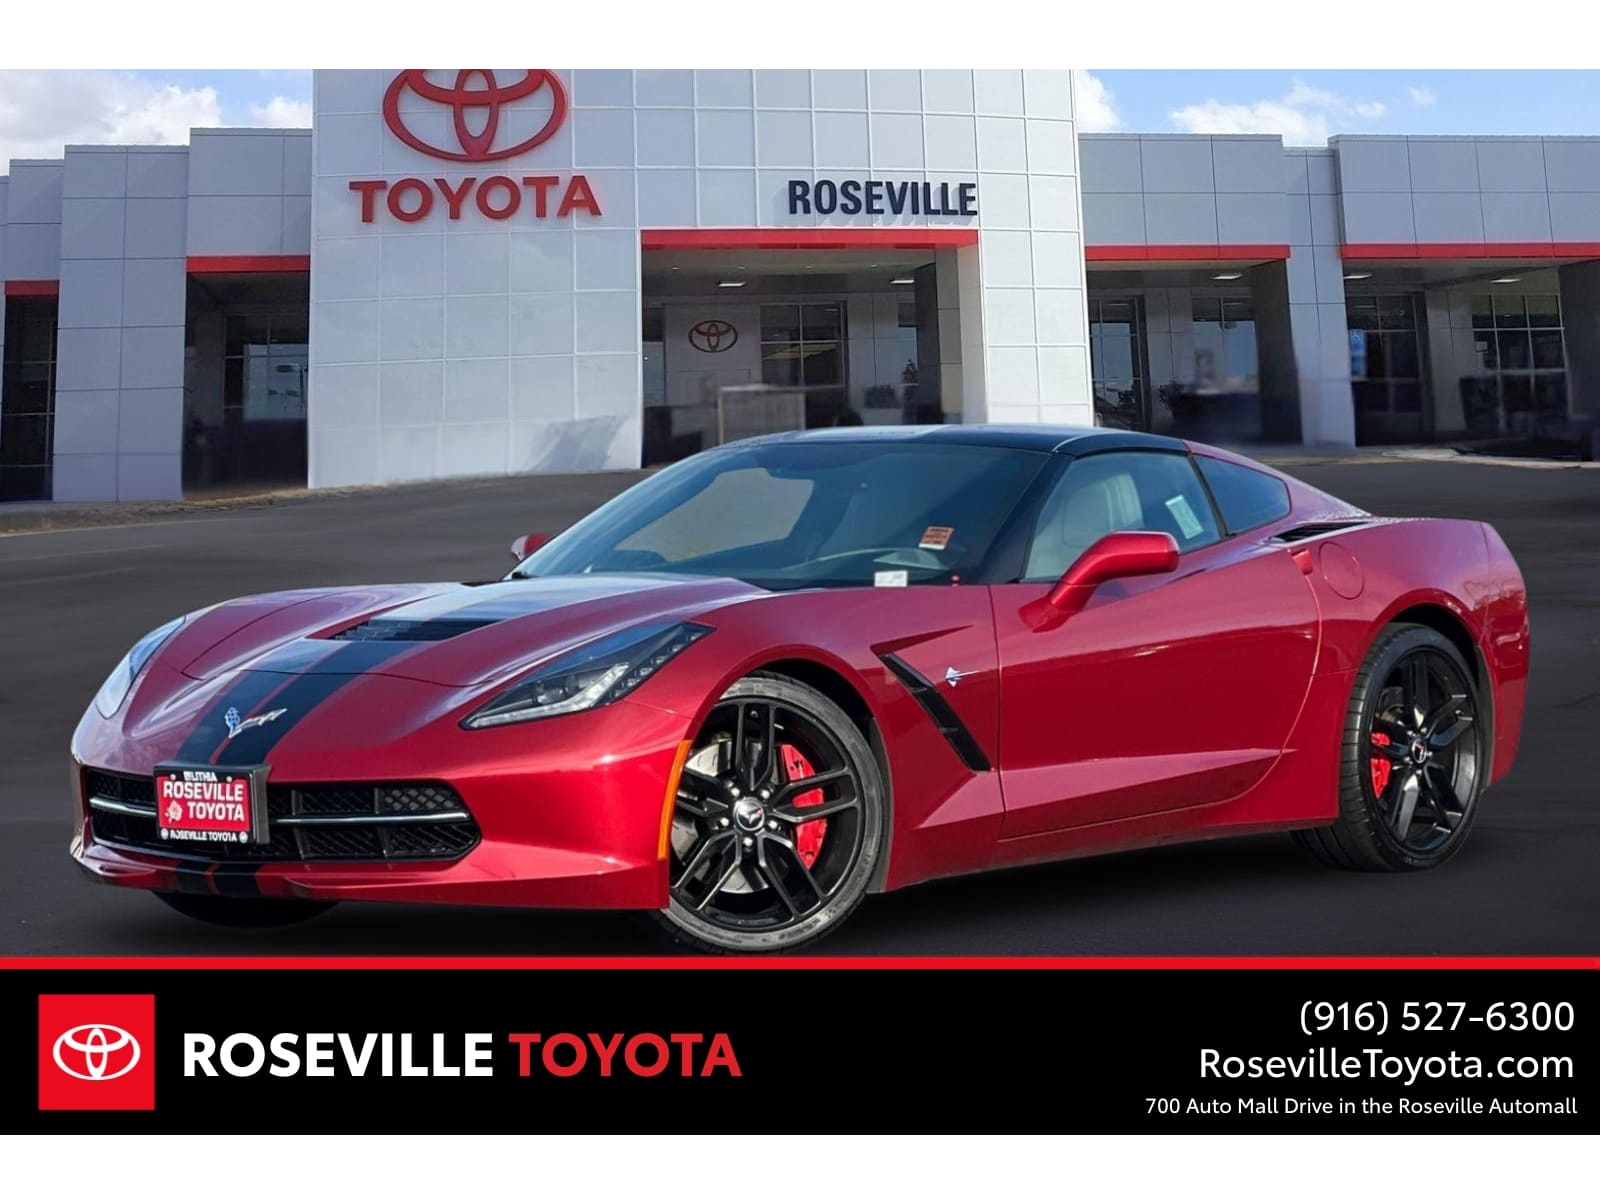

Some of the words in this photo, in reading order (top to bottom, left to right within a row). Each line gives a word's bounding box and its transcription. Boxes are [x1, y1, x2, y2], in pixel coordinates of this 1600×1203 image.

[349, 175, 602, 223] TOYOTA
[788, 179, 978, 216] ROSEVILLE
[163, 781, 243, 801] ROSEVILLE
[188, 802, 244, 821] TOYOTA
[208, 832, 237, 842] TOYOTA
